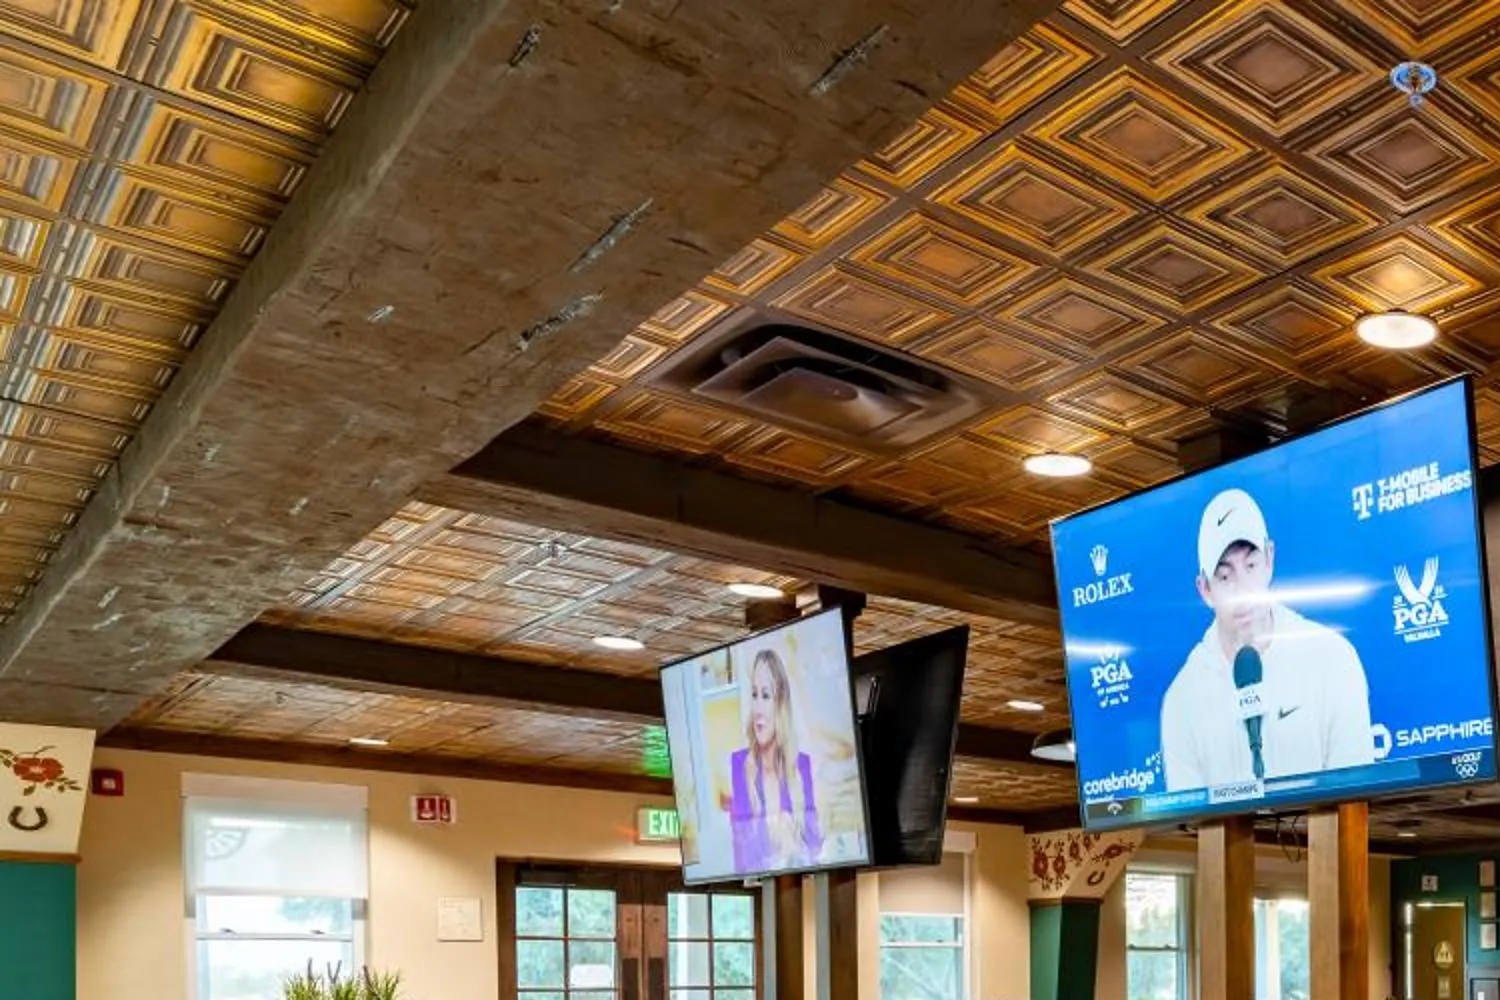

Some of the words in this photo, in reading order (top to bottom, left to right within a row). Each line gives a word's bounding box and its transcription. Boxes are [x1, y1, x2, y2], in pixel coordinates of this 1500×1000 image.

[1377, 461, 1439, 496] T-MOBILE
[1378, 491, 1405, 514] FOR
[1405, 469, 1472, 506] BUSINESS
[1072, 572, 1134, 608] ROLEX
[1393, 599, 1449, 630] PGA
[1090, 659, 1133, 689] PGA
[1395, 718, 1492, 748] SAPPHIRE
[1083, 767, 1156, 795] corebridge
